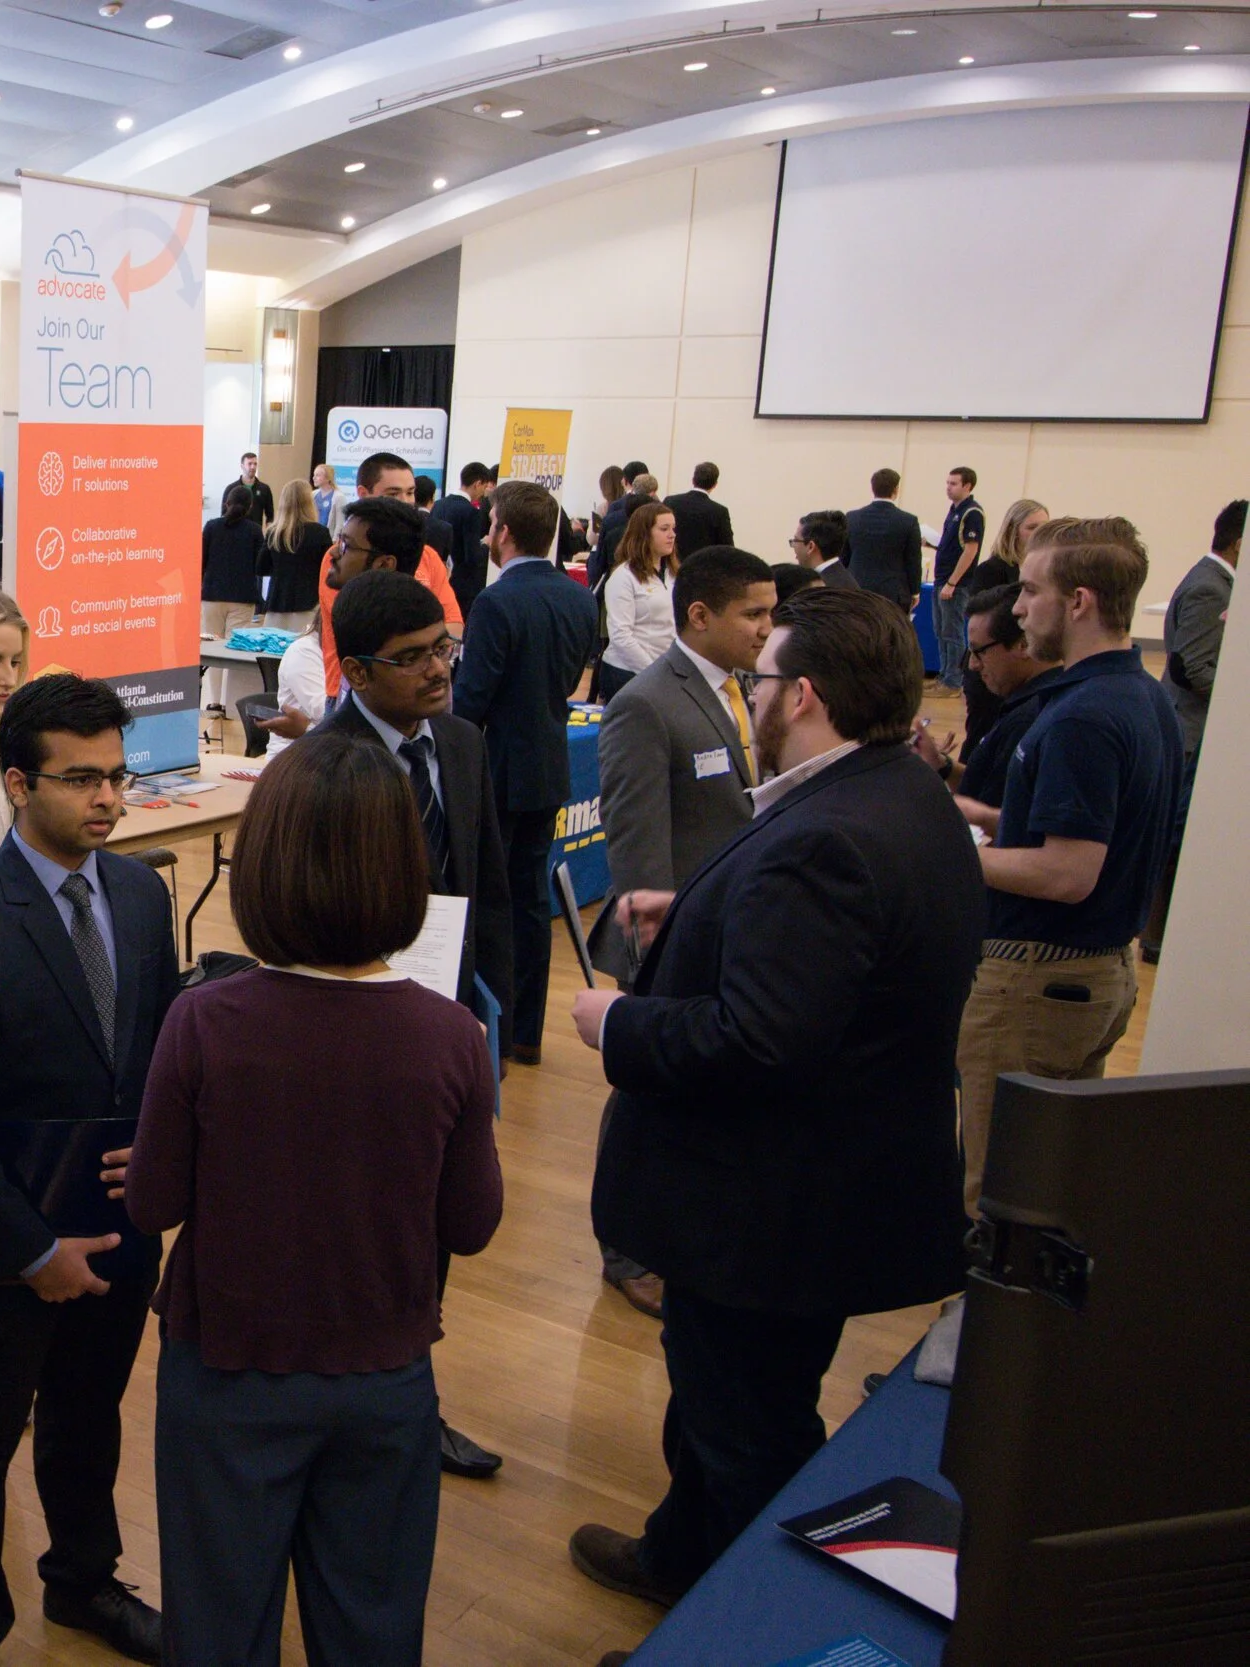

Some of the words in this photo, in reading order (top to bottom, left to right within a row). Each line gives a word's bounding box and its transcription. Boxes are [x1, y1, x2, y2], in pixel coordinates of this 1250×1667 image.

[37, 275, 106, 301] advocate
[36, 315, 71, 339] Join
[76, 318, 106, 341] Our
[36, 346, 152, 409] Team
[363, 424, 435, 441] QGenda
[72, 455, 108, 470] Deliver
[109, 455, 159, 470] innovative
[511, 454, 567, 479] STRATEGY
[72, 477, 83, 492] IT
[84, 477, 129, 492] solutions
[535, 474, 563, 491] GROUP
[71, 526, 138, 543] Collaborative
[71, 549, 124, 566] on-the-job
[125, 547, 165, 563] learning
[71, 596, 128, 615] Community
[130, 591, 182, 609] betterment
[70, 620, 91, 637] and
[92, 617, 122, 634] social
[124, 615, 157, 631] events
